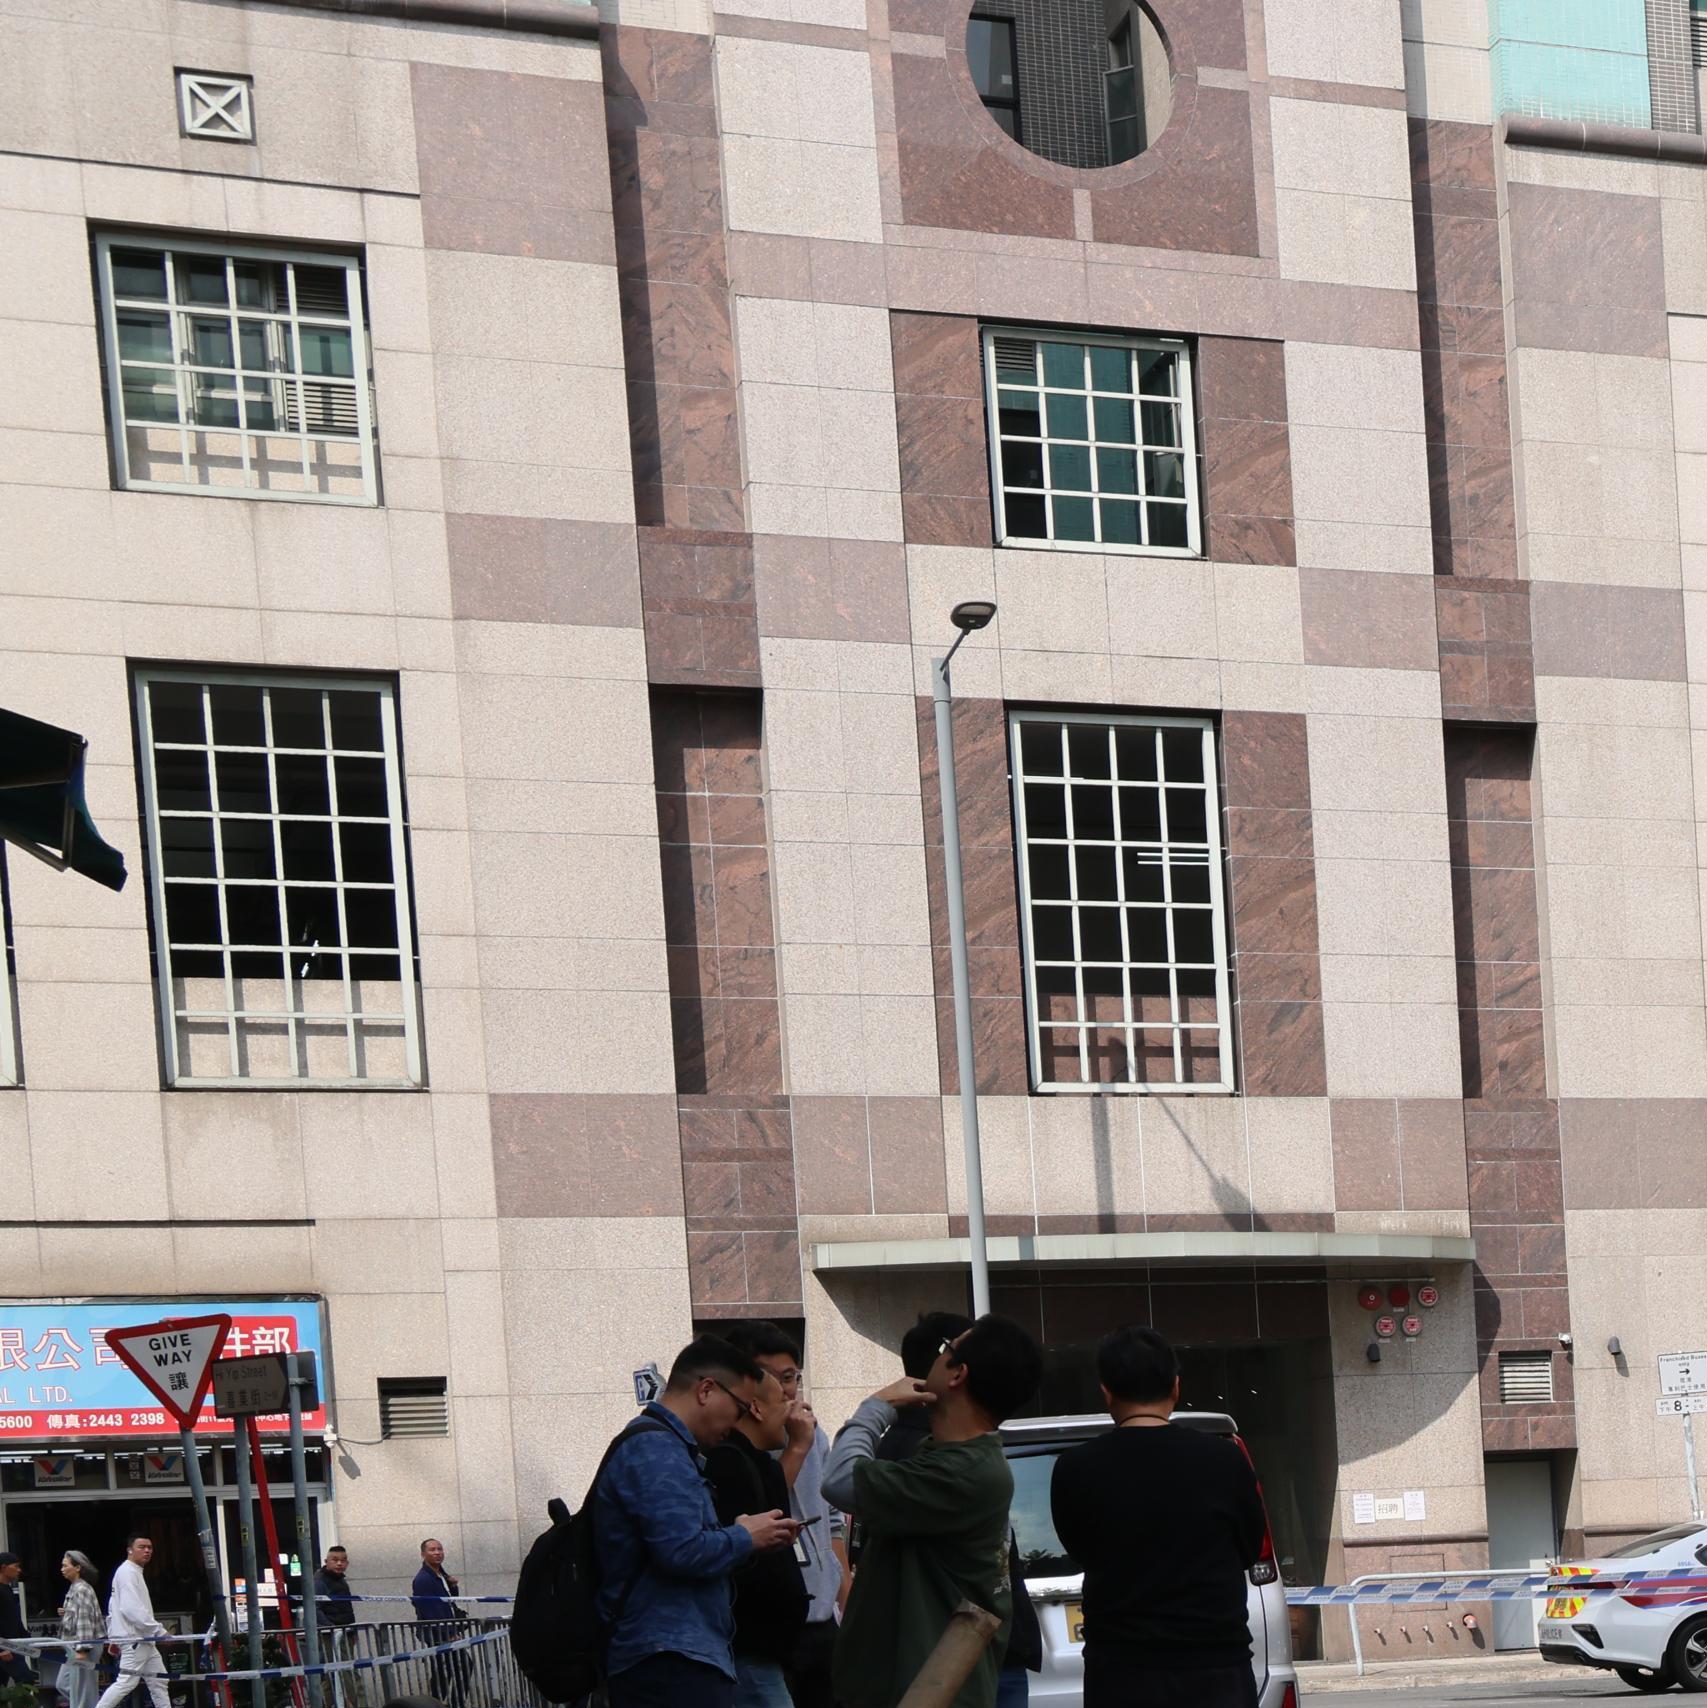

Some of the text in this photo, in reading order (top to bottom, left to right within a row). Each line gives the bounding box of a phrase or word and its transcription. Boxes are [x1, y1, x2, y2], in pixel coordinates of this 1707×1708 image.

[149, 1334, 192, 1351] GIVE
[154, 1350, 192, 1367] WAY
[168, 1371, 190, 1391] 讓
[29, 1386, 73, 1403] LTD.
[1674, 1400, 1682, 1411] 8
[131, 1413, 165, 1426] 2398
